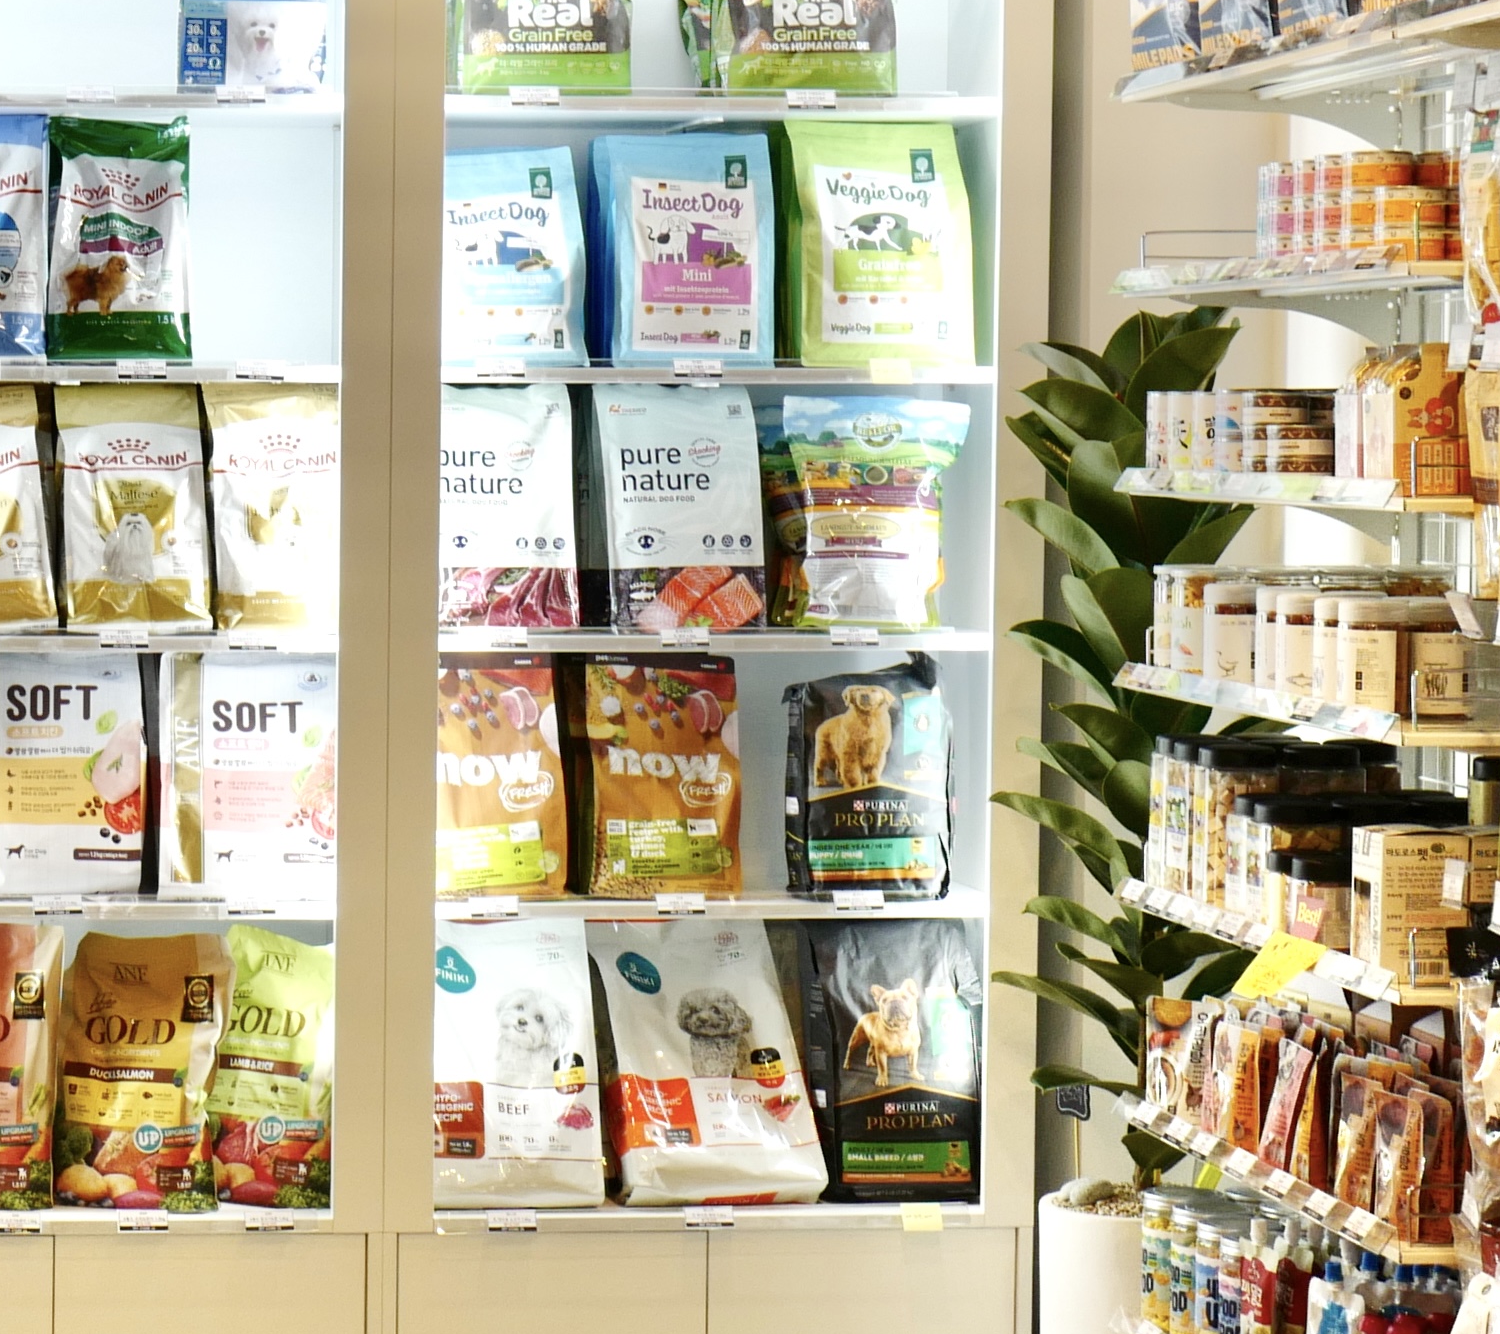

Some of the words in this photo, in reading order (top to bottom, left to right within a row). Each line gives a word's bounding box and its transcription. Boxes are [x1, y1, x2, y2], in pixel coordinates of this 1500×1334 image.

[509, 28, 553, 43] Grain
[556, 28, 593, 42] Free
[774, 27, 817, 42] Grain
[820, 27, 856, 42] Free
[73, 182, 118, 204] ROYAL
[121, 182, 169, 206] CANIN
[682, 269, 712, 283] Mini
[133, 451, 187, 466] CANIN
[621, 445, 681, 470] pure
[623, 471, 710, 492] nature
[110, 487, 158, 502] Maltese
[6, 685, 98, 720] SOFT
[213, 701, 303, 733] SOFT
[608, 746, 721, 784] now
[510, 782, 550, 798] FRESH
[689, 783, 728, 797] FRESH
[865, 800, 908, 811] PURINA
[835, 813, 874, 828] PRO
[877, 812, 925, 827] PLAN
[1296, 901, 1322, 927] Best!
[1371, 882, 1379, 963] ORGANIC
[86, 1014, 176, 1047] GOLD
[225, 1006, 305, 1038] GOLD
[708, 1092, 762, 1105] SALMON
[498, 1101, 530, 1115] BEEF
[896, 1102, 939, 1113] PURINA
[866, 1116, 905, 1131] PRO
[910, 1113, 957, 1130] PLAN
[137, 1129, 161, 1148] UP
